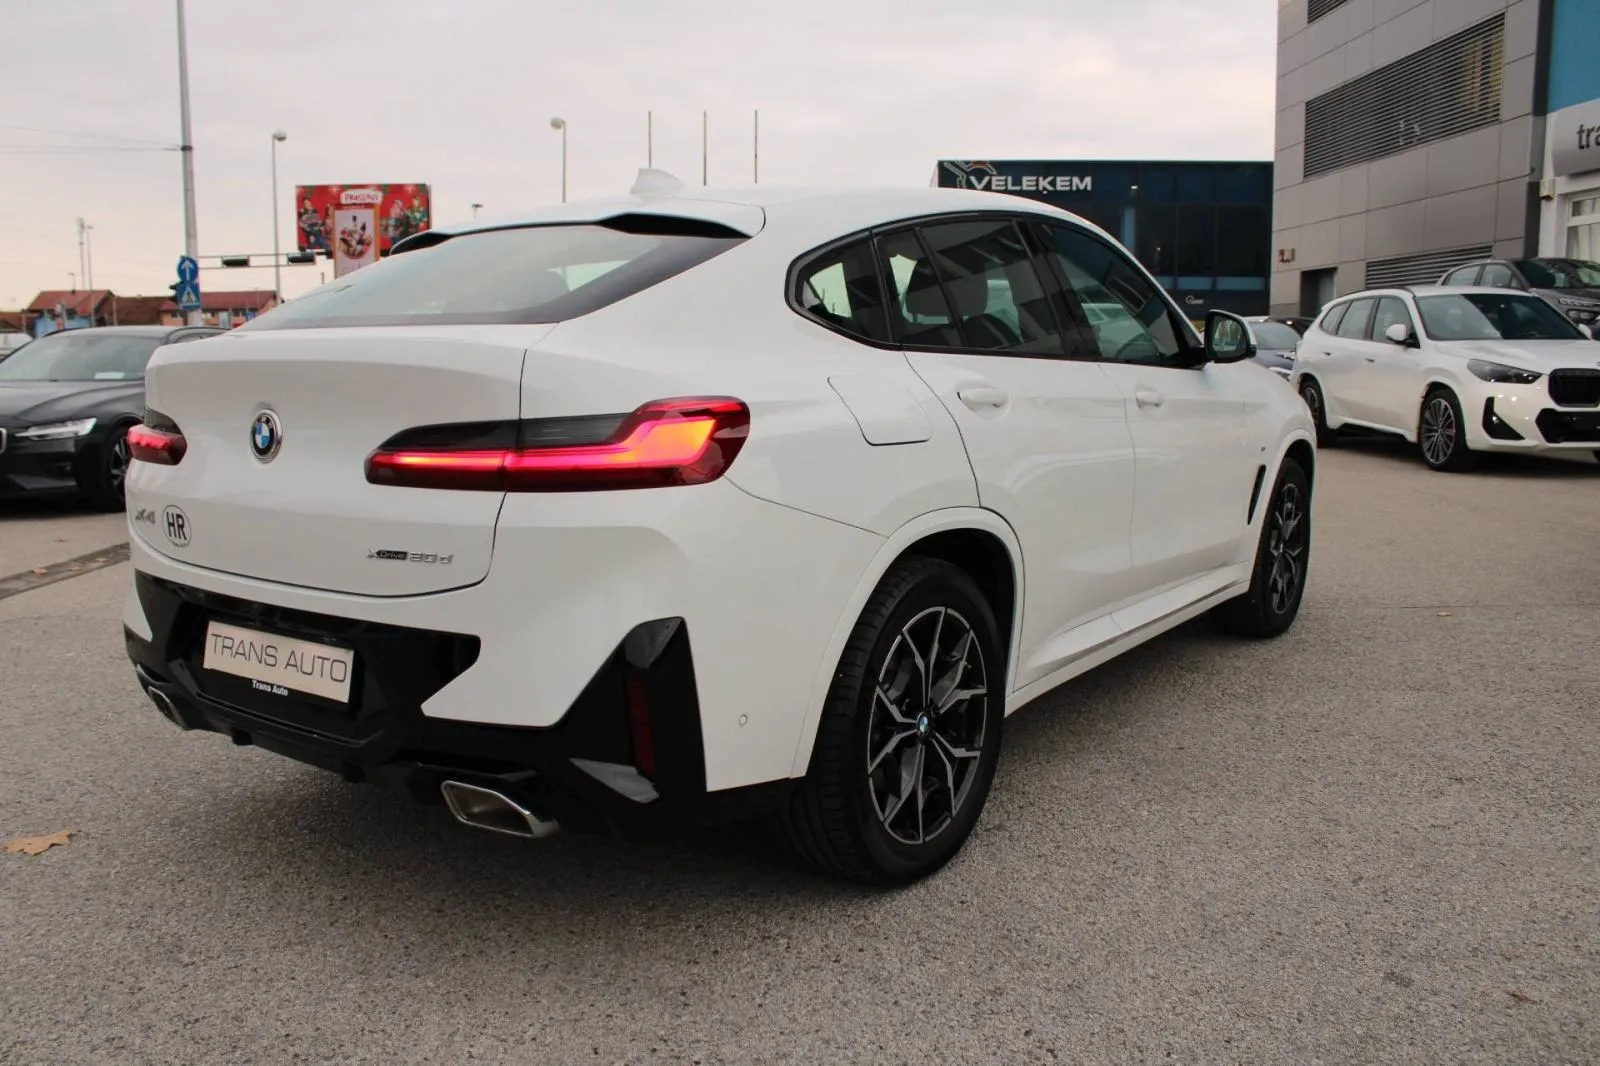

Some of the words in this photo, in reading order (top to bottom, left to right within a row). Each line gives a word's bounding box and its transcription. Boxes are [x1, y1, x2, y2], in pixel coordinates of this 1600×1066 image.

[968, 175, 1093, 191] VELEKEM
[165, 511, 188, 541] HR
[210, 633, 279, 668] TRANS
[284, 650, 348, 683] AUTO
[252, 679, 271, 692] Trans
[272, 684, 288, 697] Auto
